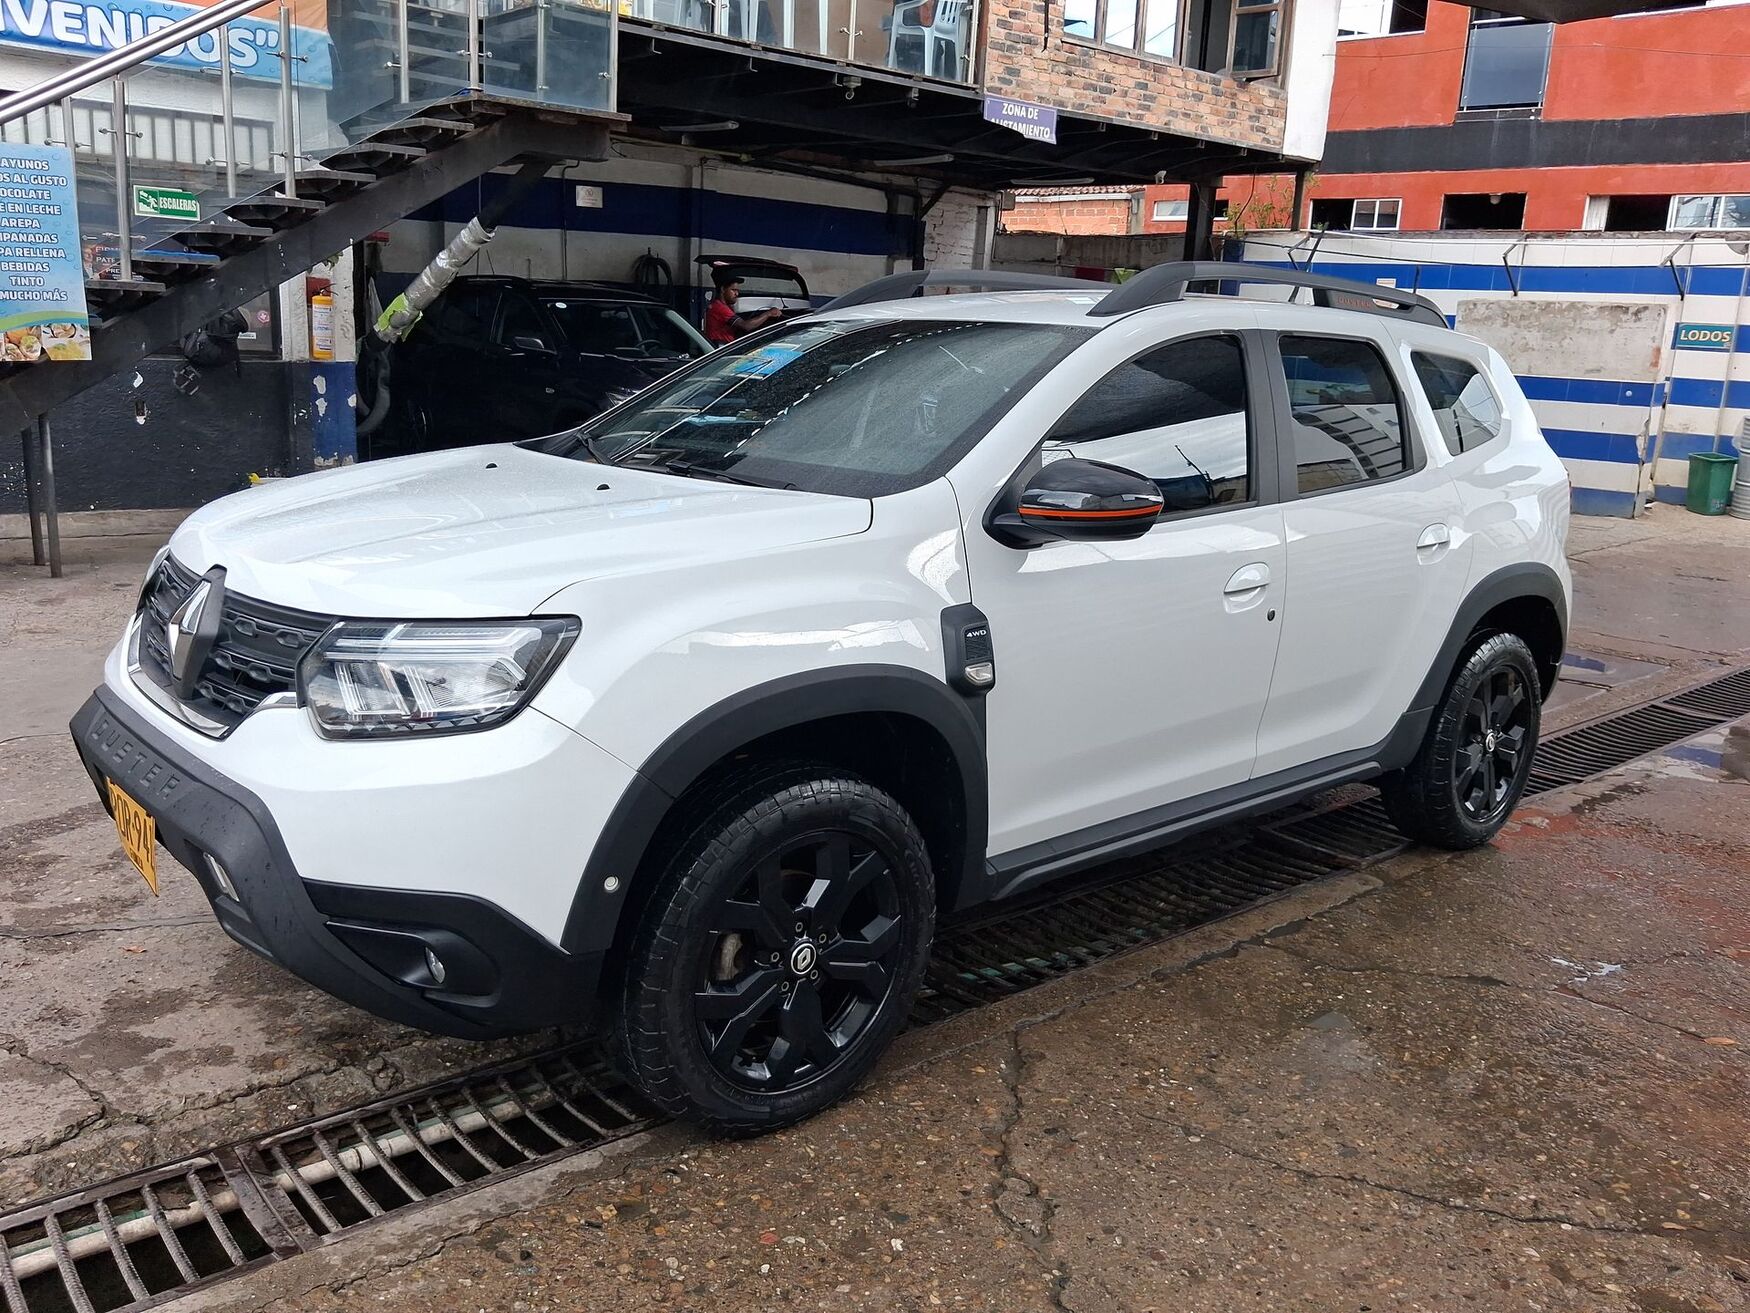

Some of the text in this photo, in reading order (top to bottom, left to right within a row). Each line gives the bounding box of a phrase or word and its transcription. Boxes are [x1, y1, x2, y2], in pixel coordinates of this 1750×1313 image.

[0, 0, 278, 68] VENIDOS"
[1002, 103, 1039, 120] ZONA DE
[13, 174, 29, 184] AL
[30, 175, 68, 187] GUSTO
[7, 203, 24, 213] EN
[26, 204, 62, 215] LECHE
[159, 197, 197, 211] ESCALERAS
[1, 218, 40, 228] AREPA
[15, 248, 66, 258] RELLENA
[1, 262, 50, 272] BEBIDAS
[9, 276, 45, 286] TINTO
[0, 288, 68, 301] MUCHO MÁS
[1680, 329, 1732, 342] LODOS
[966, 629, 987, 638] 4WD
